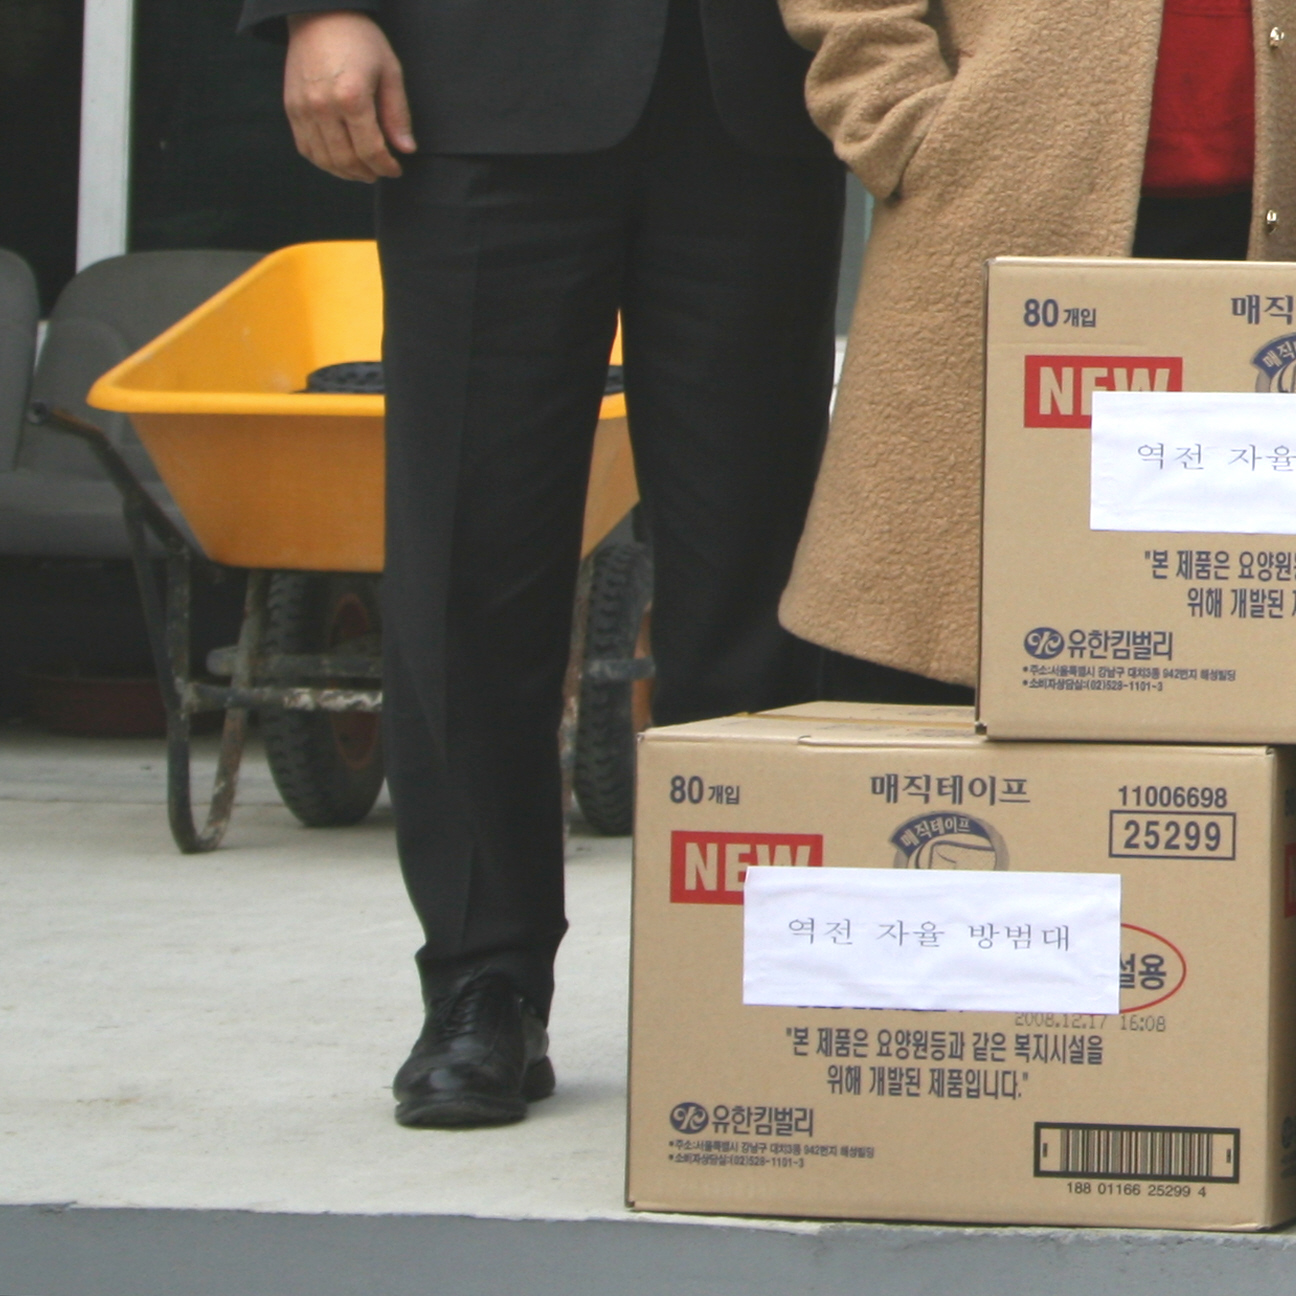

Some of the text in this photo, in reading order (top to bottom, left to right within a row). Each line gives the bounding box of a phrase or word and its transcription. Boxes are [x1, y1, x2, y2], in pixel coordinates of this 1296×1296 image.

[1138, 443, 1203, 470] 역전
[1176, 550, 1230, 580] 제품은
[1187, 588, 1222, 618] 위해
[1231, 589, 1283, 619] 개발된
[1067, 629, 1173, 661] 유한킴벌리
[870, 774, 1030, 806] 매직테이프
[1119, 786, 1227, 809] 11006698
[898, 814, 972, 849] 매직테이프
[1120, 820, 1221, 855] 25299
[789, 918, 1068, 951] 역전 자율 방범대
[816, 1028, 868, 1058] 제품은
[876, 1029, 965, 1061] 요양원등과
[973, 1032, 1006, 1062] 같은
[1014, 1034, 1103, 1065] 복지시설을
[827, 1065, 861, 1095] 위해
[869, 1067, 920, 1097] 개발된
[712, 1105, 813, 1137] 유한킴벌리
[1068, 1182, 1206, 1197] 188 01166 25299 4
